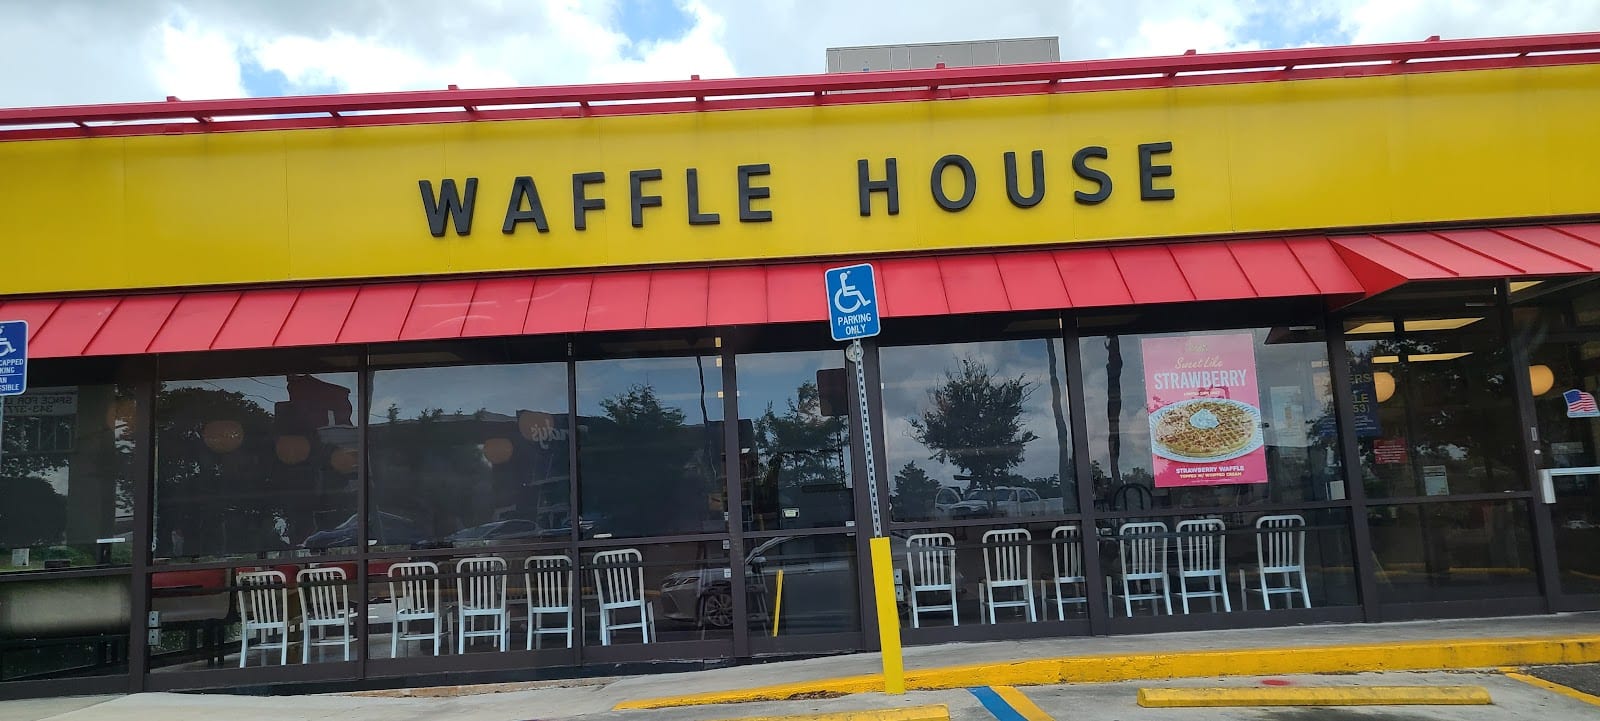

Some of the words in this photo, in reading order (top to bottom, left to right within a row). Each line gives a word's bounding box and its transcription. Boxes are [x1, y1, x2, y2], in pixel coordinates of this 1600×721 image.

[418, 163, 773, 238] WAFFLE
[857, 141, 1176, 217] HOUSE
[837, 312, 872, 327] PARKING
[845, 324, 867, 336] ONLY
[1153, 369, 1247, 391] STRAWBERRY
[1175, 466, 1218, 475] STRAWBERRY
